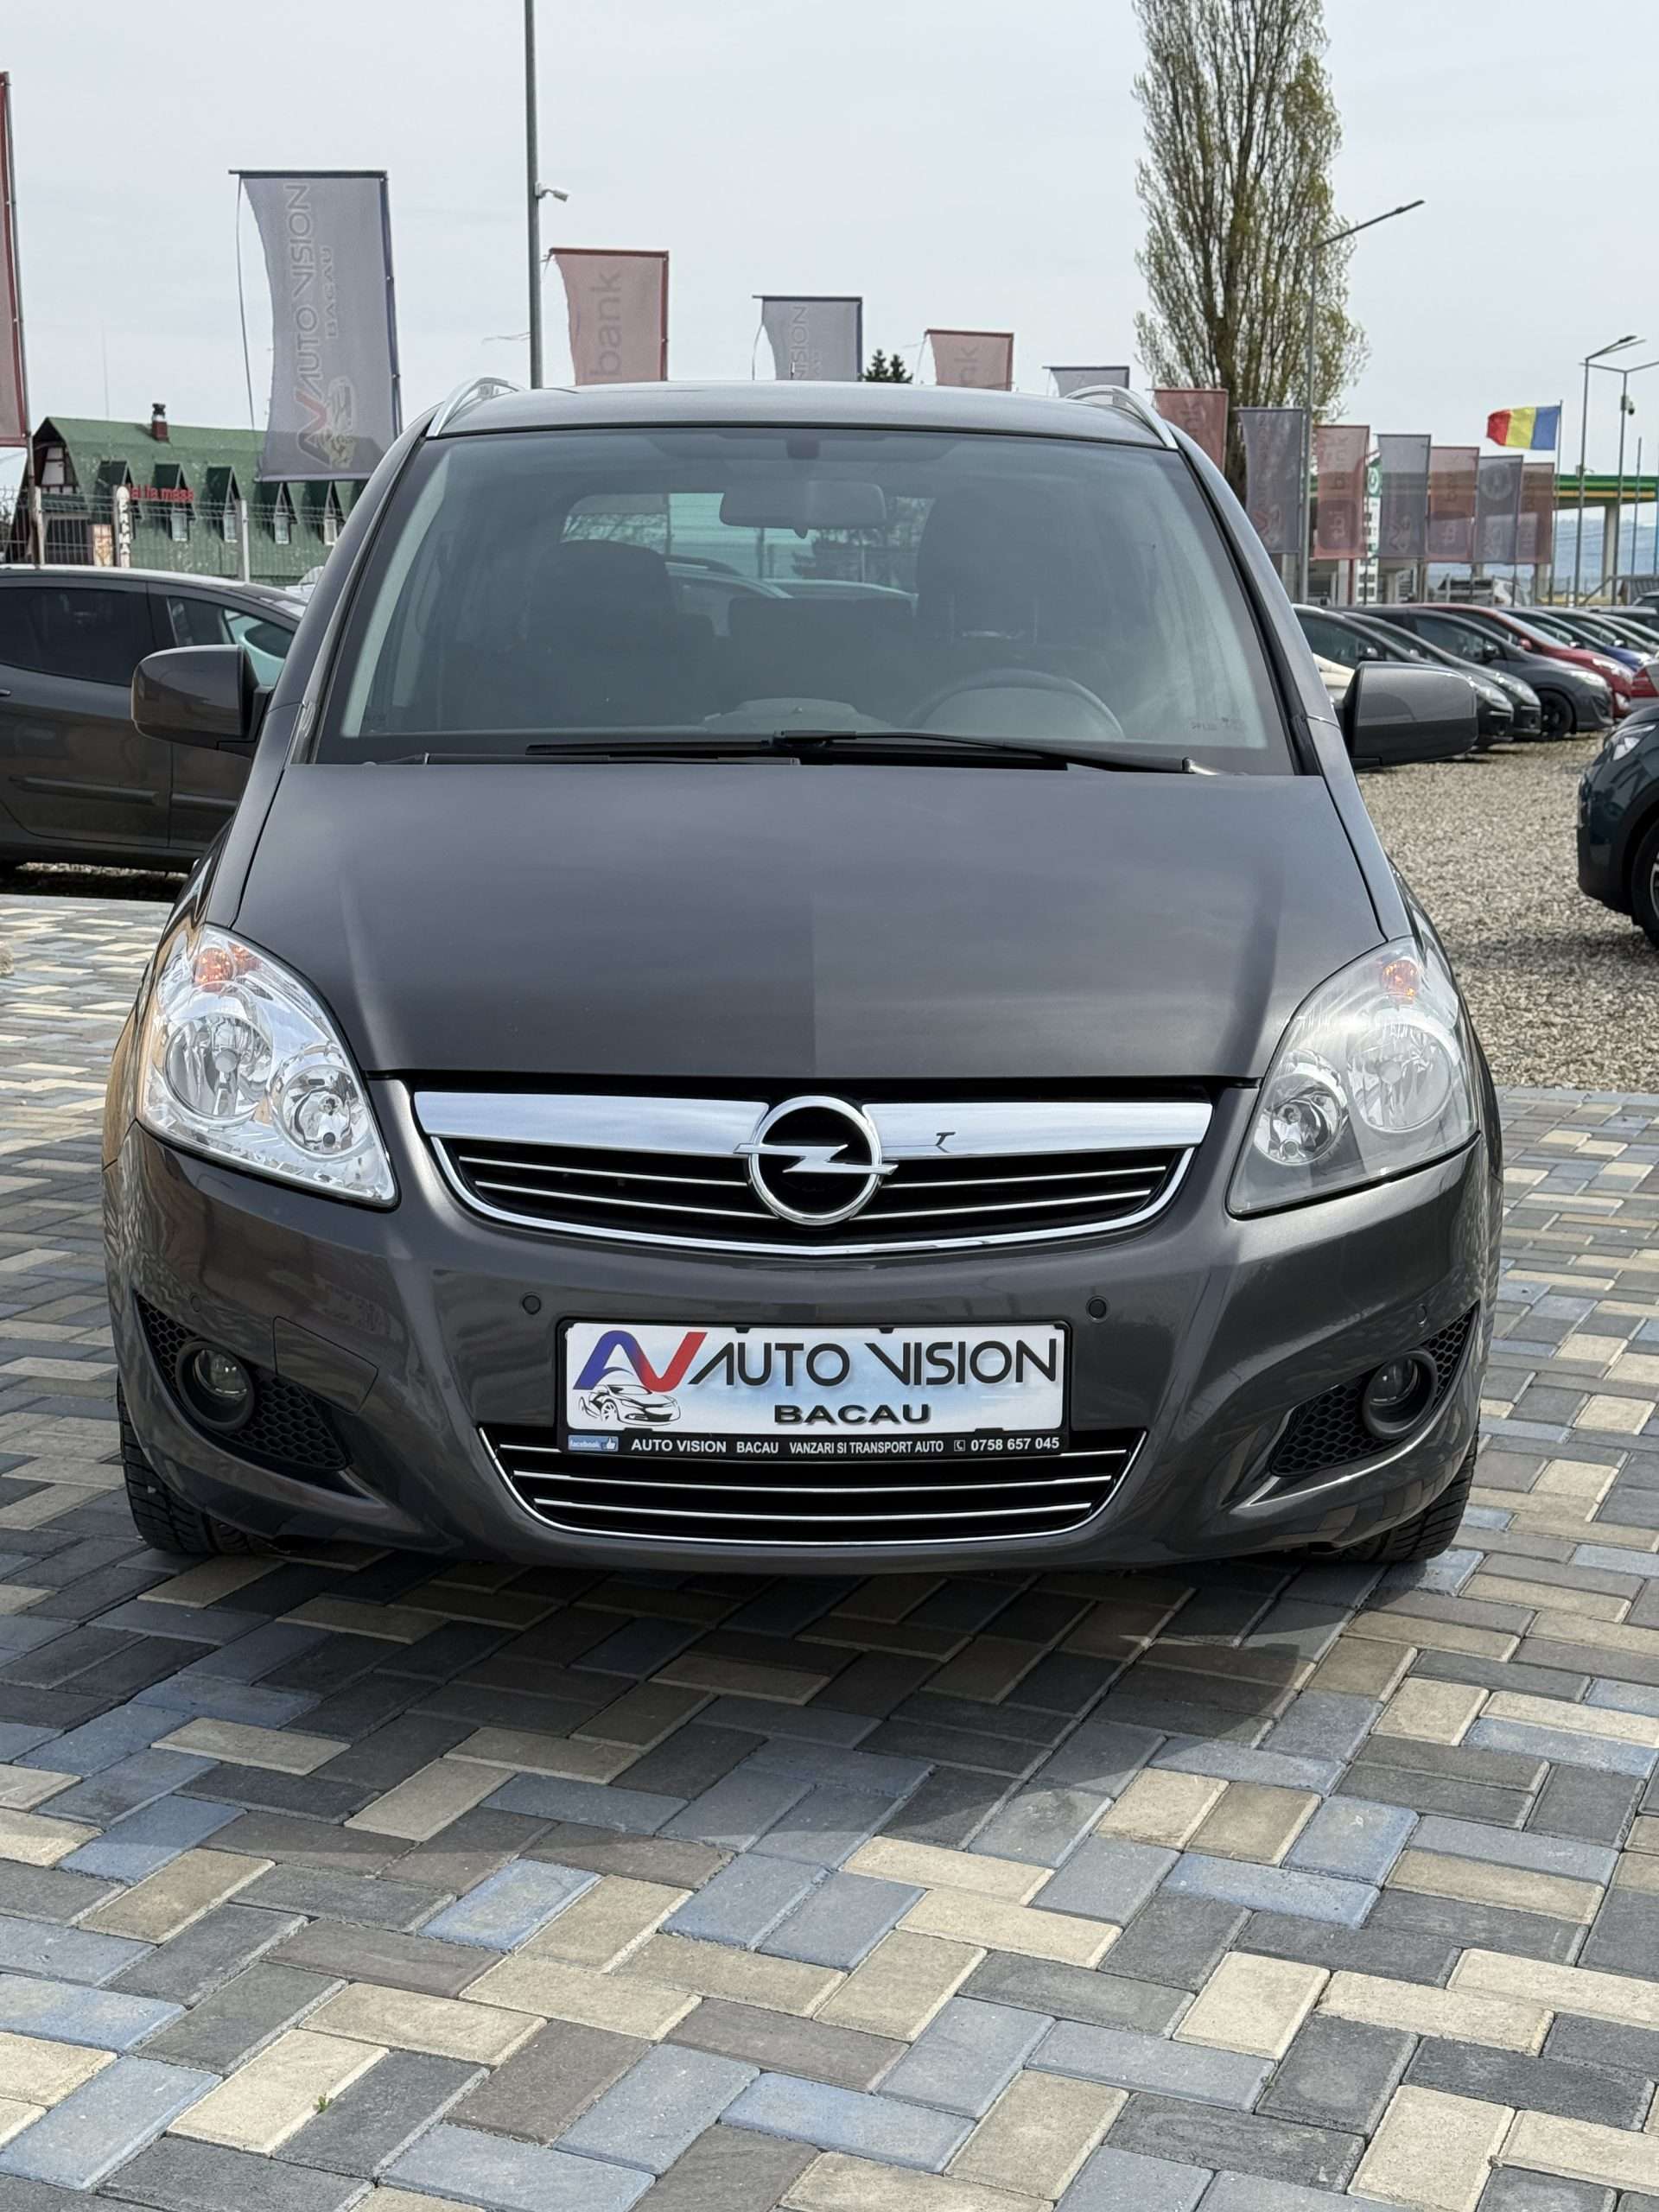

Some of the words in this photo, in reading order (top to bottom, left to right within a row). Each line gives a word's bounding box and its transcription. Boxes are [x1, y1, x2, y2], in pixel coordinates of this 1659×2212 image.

[284, 182, 315, 298] VISION
[296, 307, 322, 399] AUTO
[589, 270, 621, 377] bank
[688, 1341, 850, 1387] AUTO
[864, 1338, 1058, 1386] VISION
[631, 1439, 673, 1452] AUTO
[677, 1440, 727, 1453] VISION
[736, 1441, 779, 1453] BACAU
[790, 1441, 834, 1454] VANZARI
[837, 1440, 847, 1453] SI
[849, 1440, 912, 1453] TRANSPORT
[914, 1440, 944, 1452] AUTO
[970, 1438, 1003, 1452] 0758
[1007, 1438, 1031, 1451] 657
[1035, 1437, 1060, 1449] 045
[774, 1403, 931, 1426] BACAU
